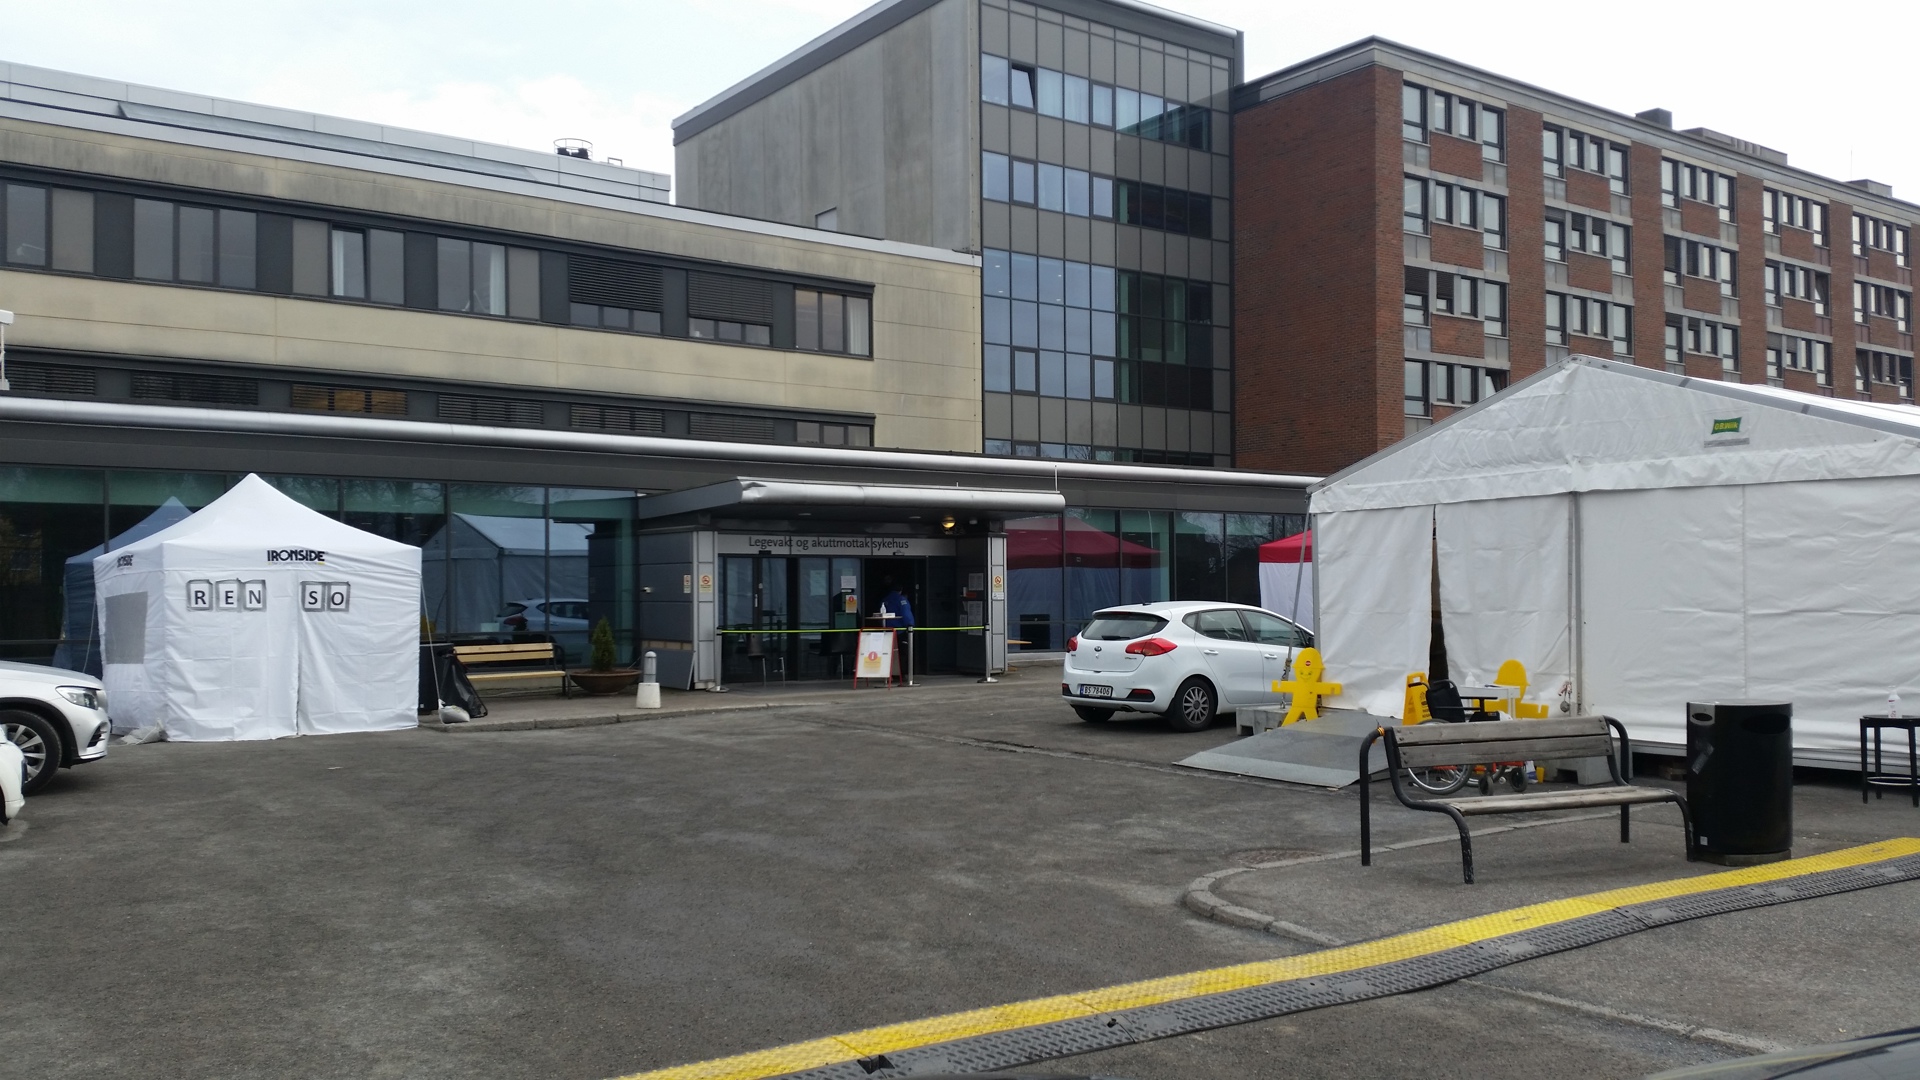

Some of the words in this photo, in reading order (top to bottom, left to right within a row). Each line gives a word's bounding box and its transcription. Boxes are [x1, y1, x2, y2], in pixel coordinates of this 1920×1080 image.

[748, 535, 794, 549] Legevakt
[796, 538, 809, 550] og
[811, 536, 870, 549] akuttmottak
[872, 537, 909, 551] sykehus
[266, 549, 326, 562] IRONSIDE
[193, 590, 262, 605] REN
[307, 590, 345, 606] SO
